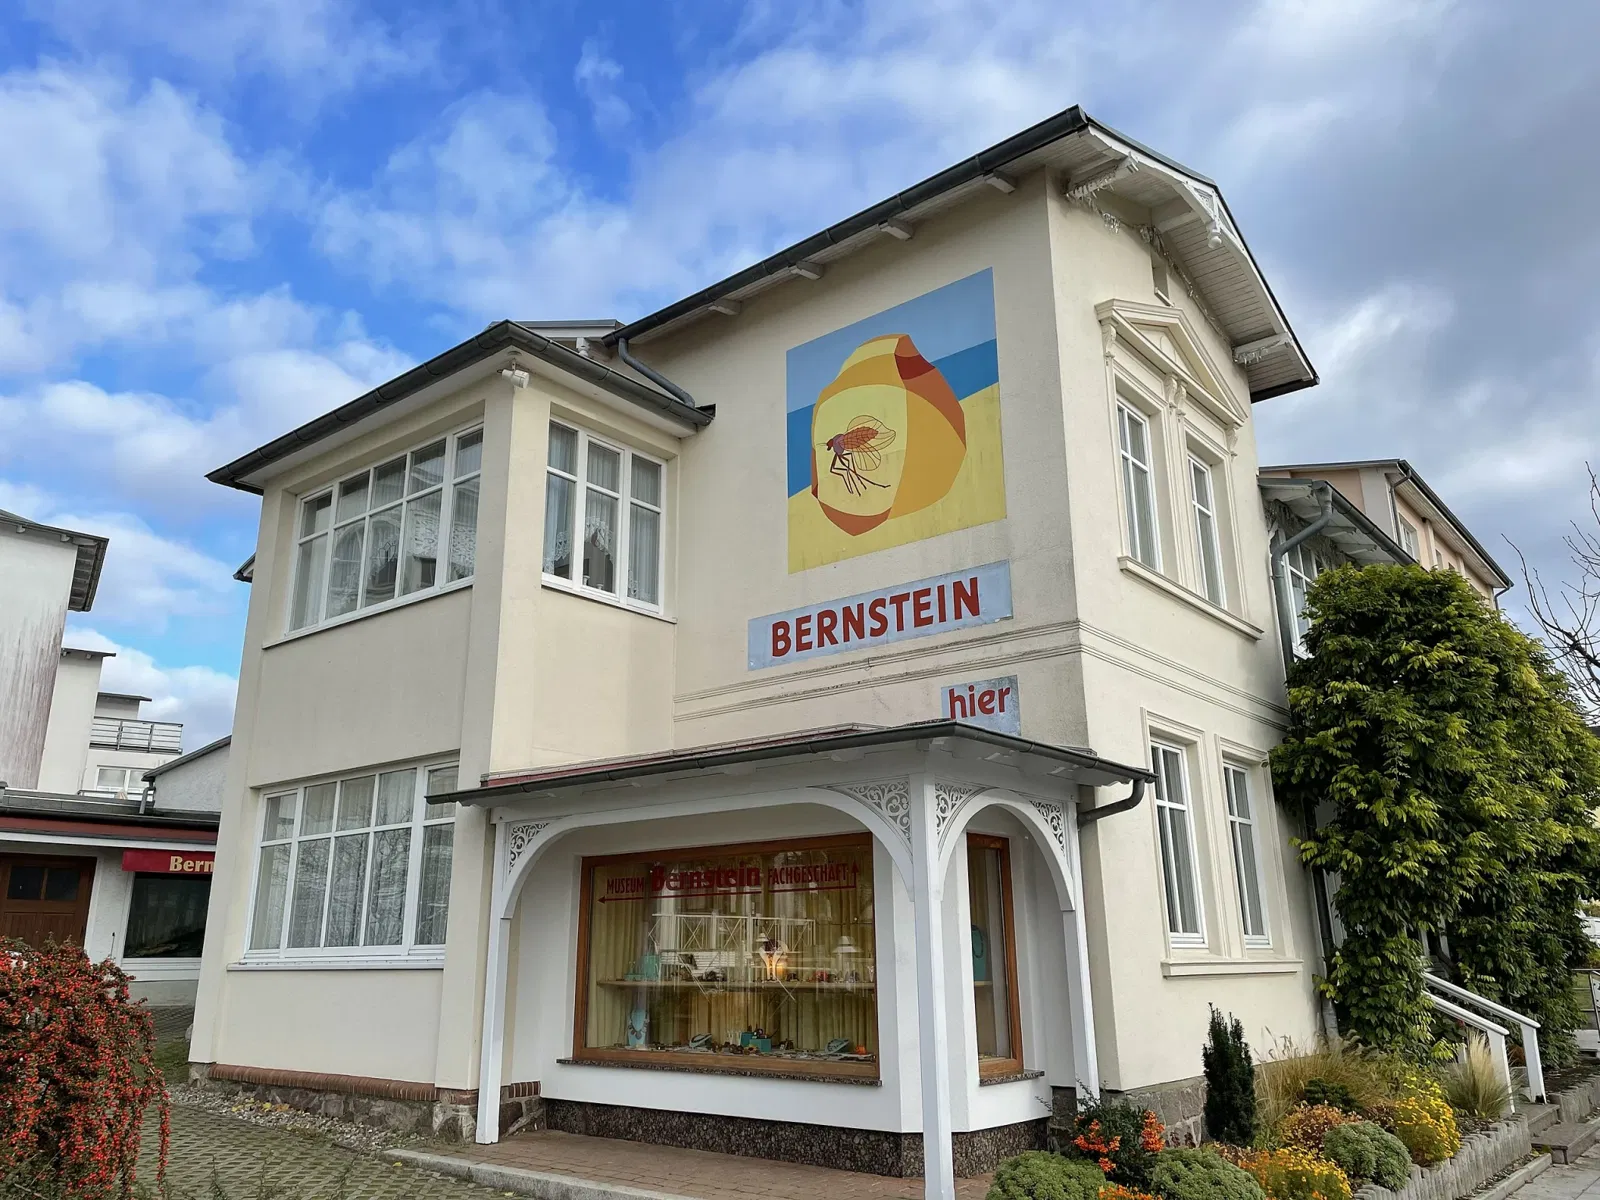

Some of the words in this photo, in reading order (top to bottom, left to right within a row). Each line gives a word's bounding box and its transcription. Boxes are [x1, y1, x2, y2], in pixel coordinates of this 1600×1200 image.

[772, 576, 980, 657] BERNSTEIN
[948, 685, 1011, 719] hier
[606, 877, 645, 894] MUSEUM
[651, 861, 762, 892] Bernstein
[767, 861, 849, 885] FACHGESCHÄFT
